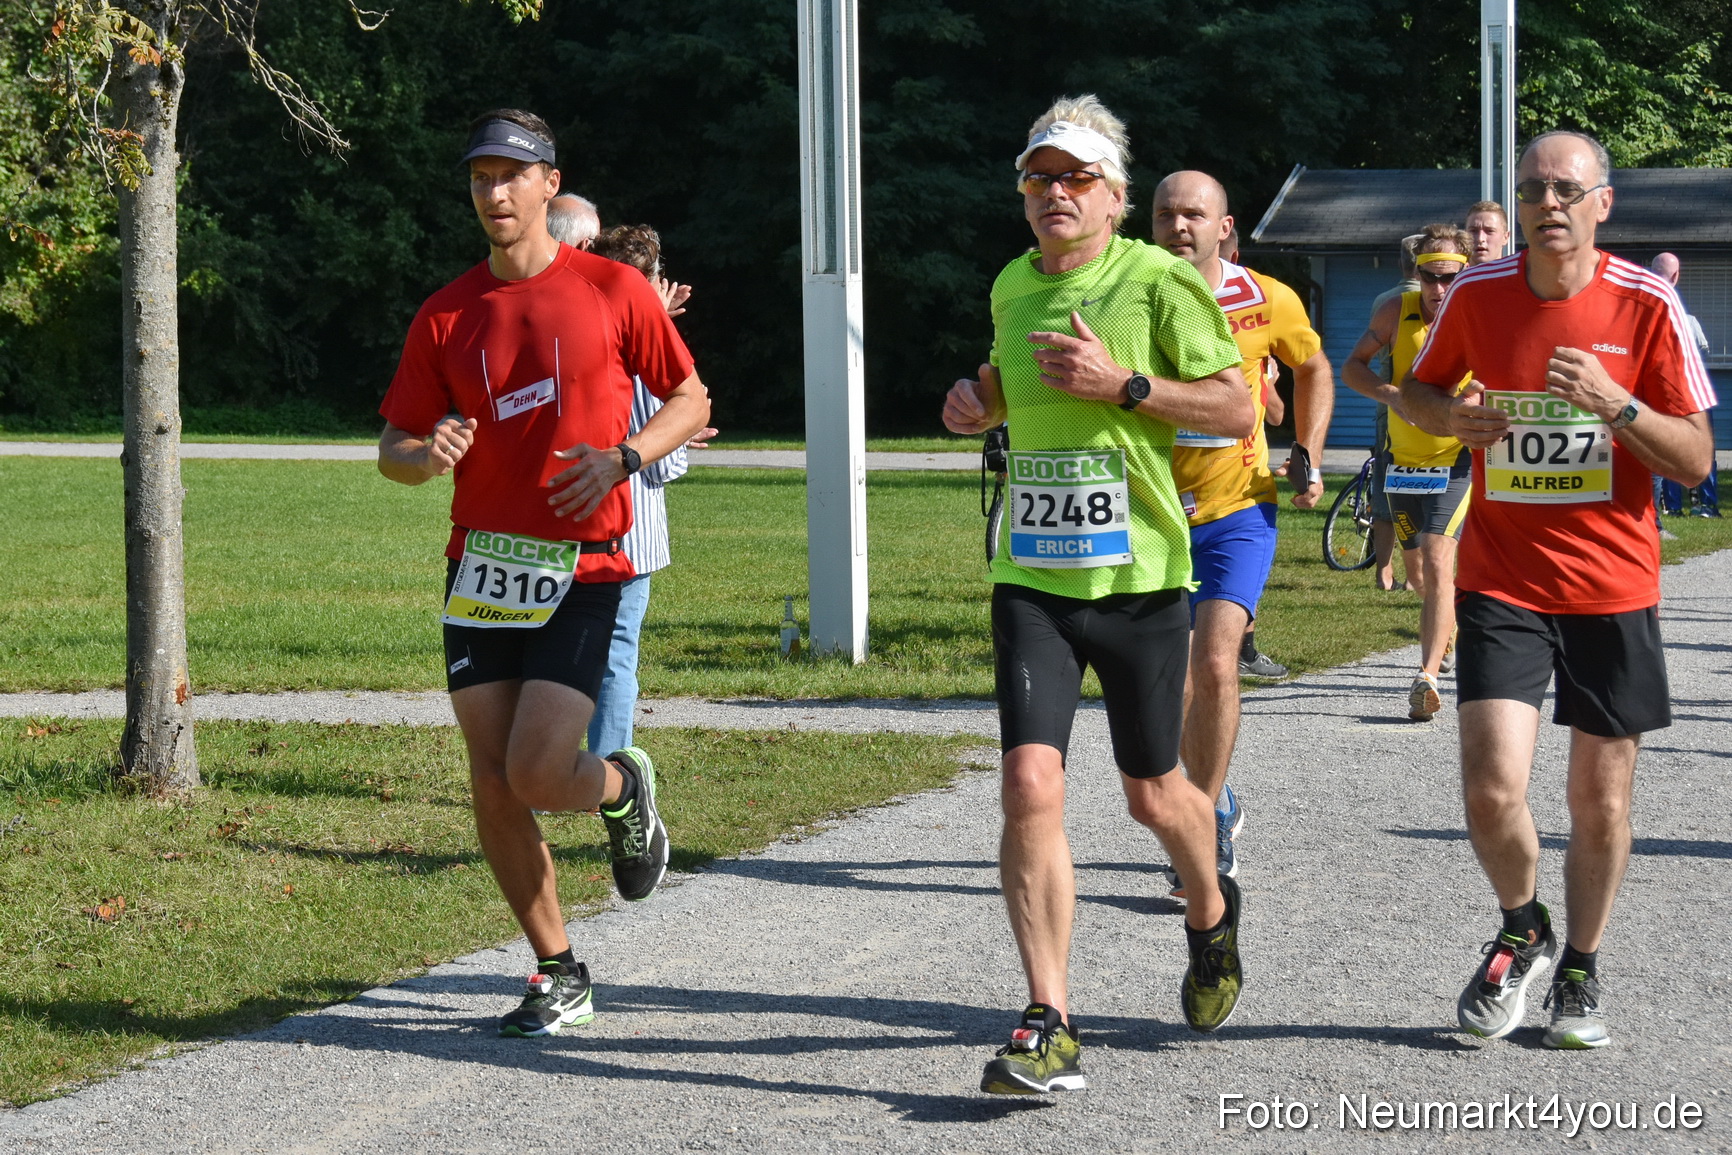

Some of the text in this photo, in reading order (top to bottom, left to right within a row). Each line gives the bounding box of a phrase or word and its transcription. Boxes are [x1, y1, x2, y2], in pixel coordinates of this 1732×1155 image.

[507, 135, 535, 149] 2XU
[1592, 343, 1627, 355] adidas
[513, 390, 537, 409] DEHN
[1501, 431, 1595, 465] 1027
[1013, 454, 1115, 482] BOCK
[1391, 476, 1440, 494] Speedy
[1510, 475, 1583, 490] ALFRED
[1020, 491, 1113, 528] 2248
[473, 531, 567, 569] BOCK
[1036, 539, 1093, 554] ERICH
[474, 563, 559, 604] 1310
[467, 605, 535, 621] JÜRGEN
